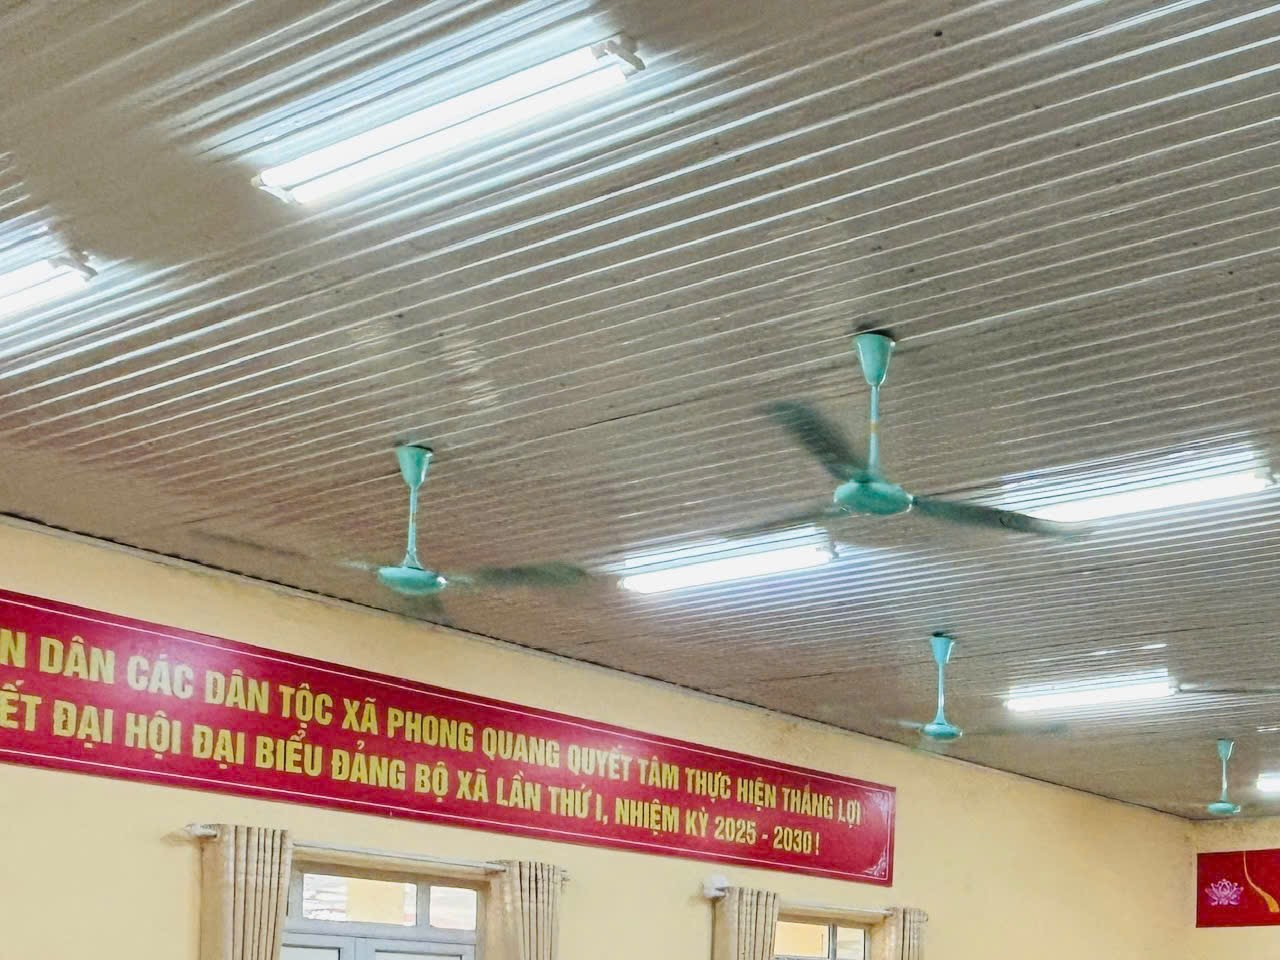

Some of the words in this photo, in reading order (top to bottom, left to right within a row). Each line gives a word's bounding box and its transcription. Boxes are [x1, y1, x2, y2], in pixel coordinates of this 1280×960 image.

[39, 635, 115, 684] DÂN
[127, 648, 194, 699] CÁC
[204, 668, 270, 715] DÂN
[278, 683, 333, 729] TỘC
[342, 697, 378, 736] XÃ
[388, 707, 473, 753] PHONG
[482, 727, 559, 768] QUANG
[567, 742, 632, 782] QUYẾT
[638, 755, 678, 791] TÂM
[685, 768, 731, 798] THỰC
[737, 776, 776, 812] HIỆN
[782, 781, 833, 820] THẮNG
[838, 798, 861, 830] LỢI
[53, 699, 114, 749] ĐẠI
[125, 710, 182, 760] HỘI
[192, 724, 245, 769] ĐẠI
[256, 729, 323, 777] BIỂU
[331, 741, 405, 790] ĐẢNG
[415, 761, 449, 803] BỘ
[457, 768, 489, 804] XÃ
[497, 769, 540, 812] LẦN
[548, 782, 590, 819] THỨ
[615, 797, 680, 836] NHIỆM
[685, 806, 708, 838] KỲ
[714, 817, 756, 845] 2025
